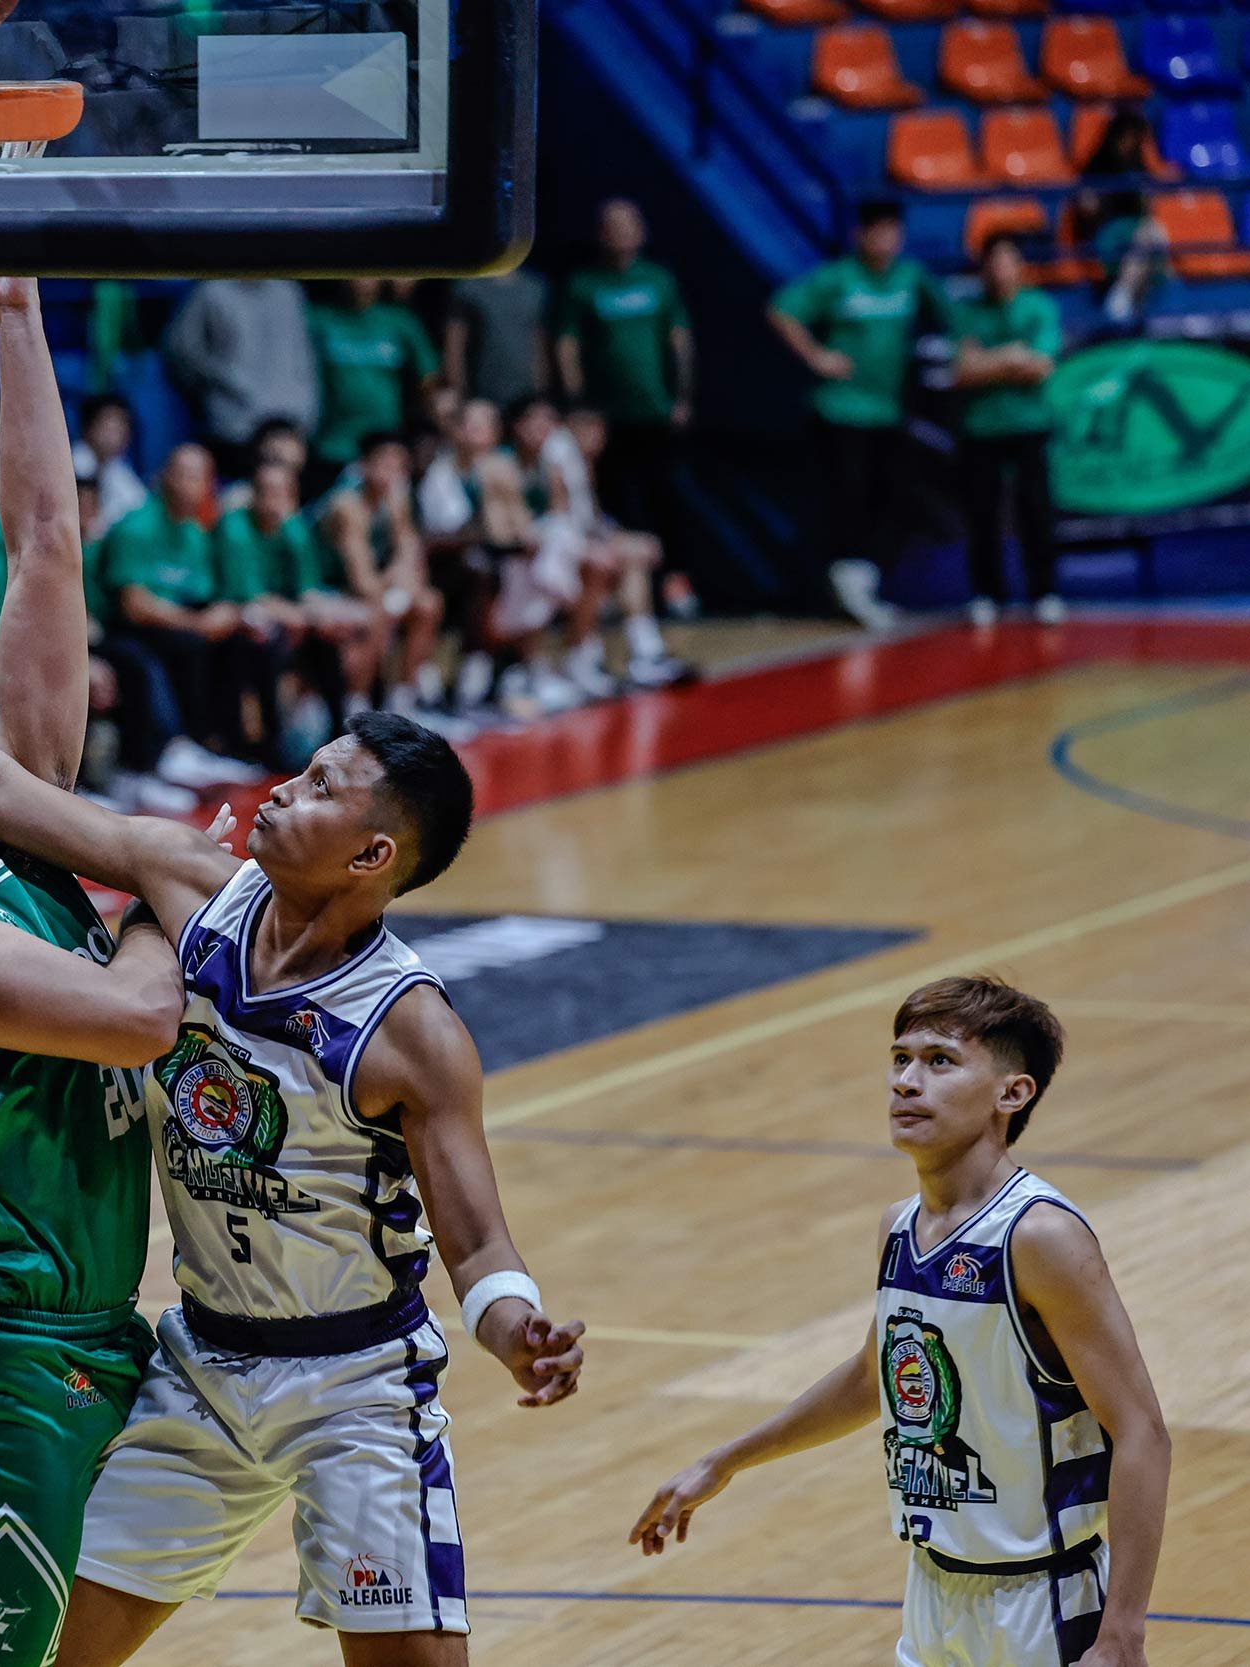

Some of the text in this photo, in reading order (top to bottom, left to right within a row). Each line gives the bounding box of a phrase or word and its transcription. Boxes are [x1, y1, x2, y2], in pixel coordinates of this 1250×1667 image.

[226, 1212, 252, 1265] 5
[353, 1569, 392, 1588] PBA
[338, 1588, 414, 1606] D-LEAGUE
